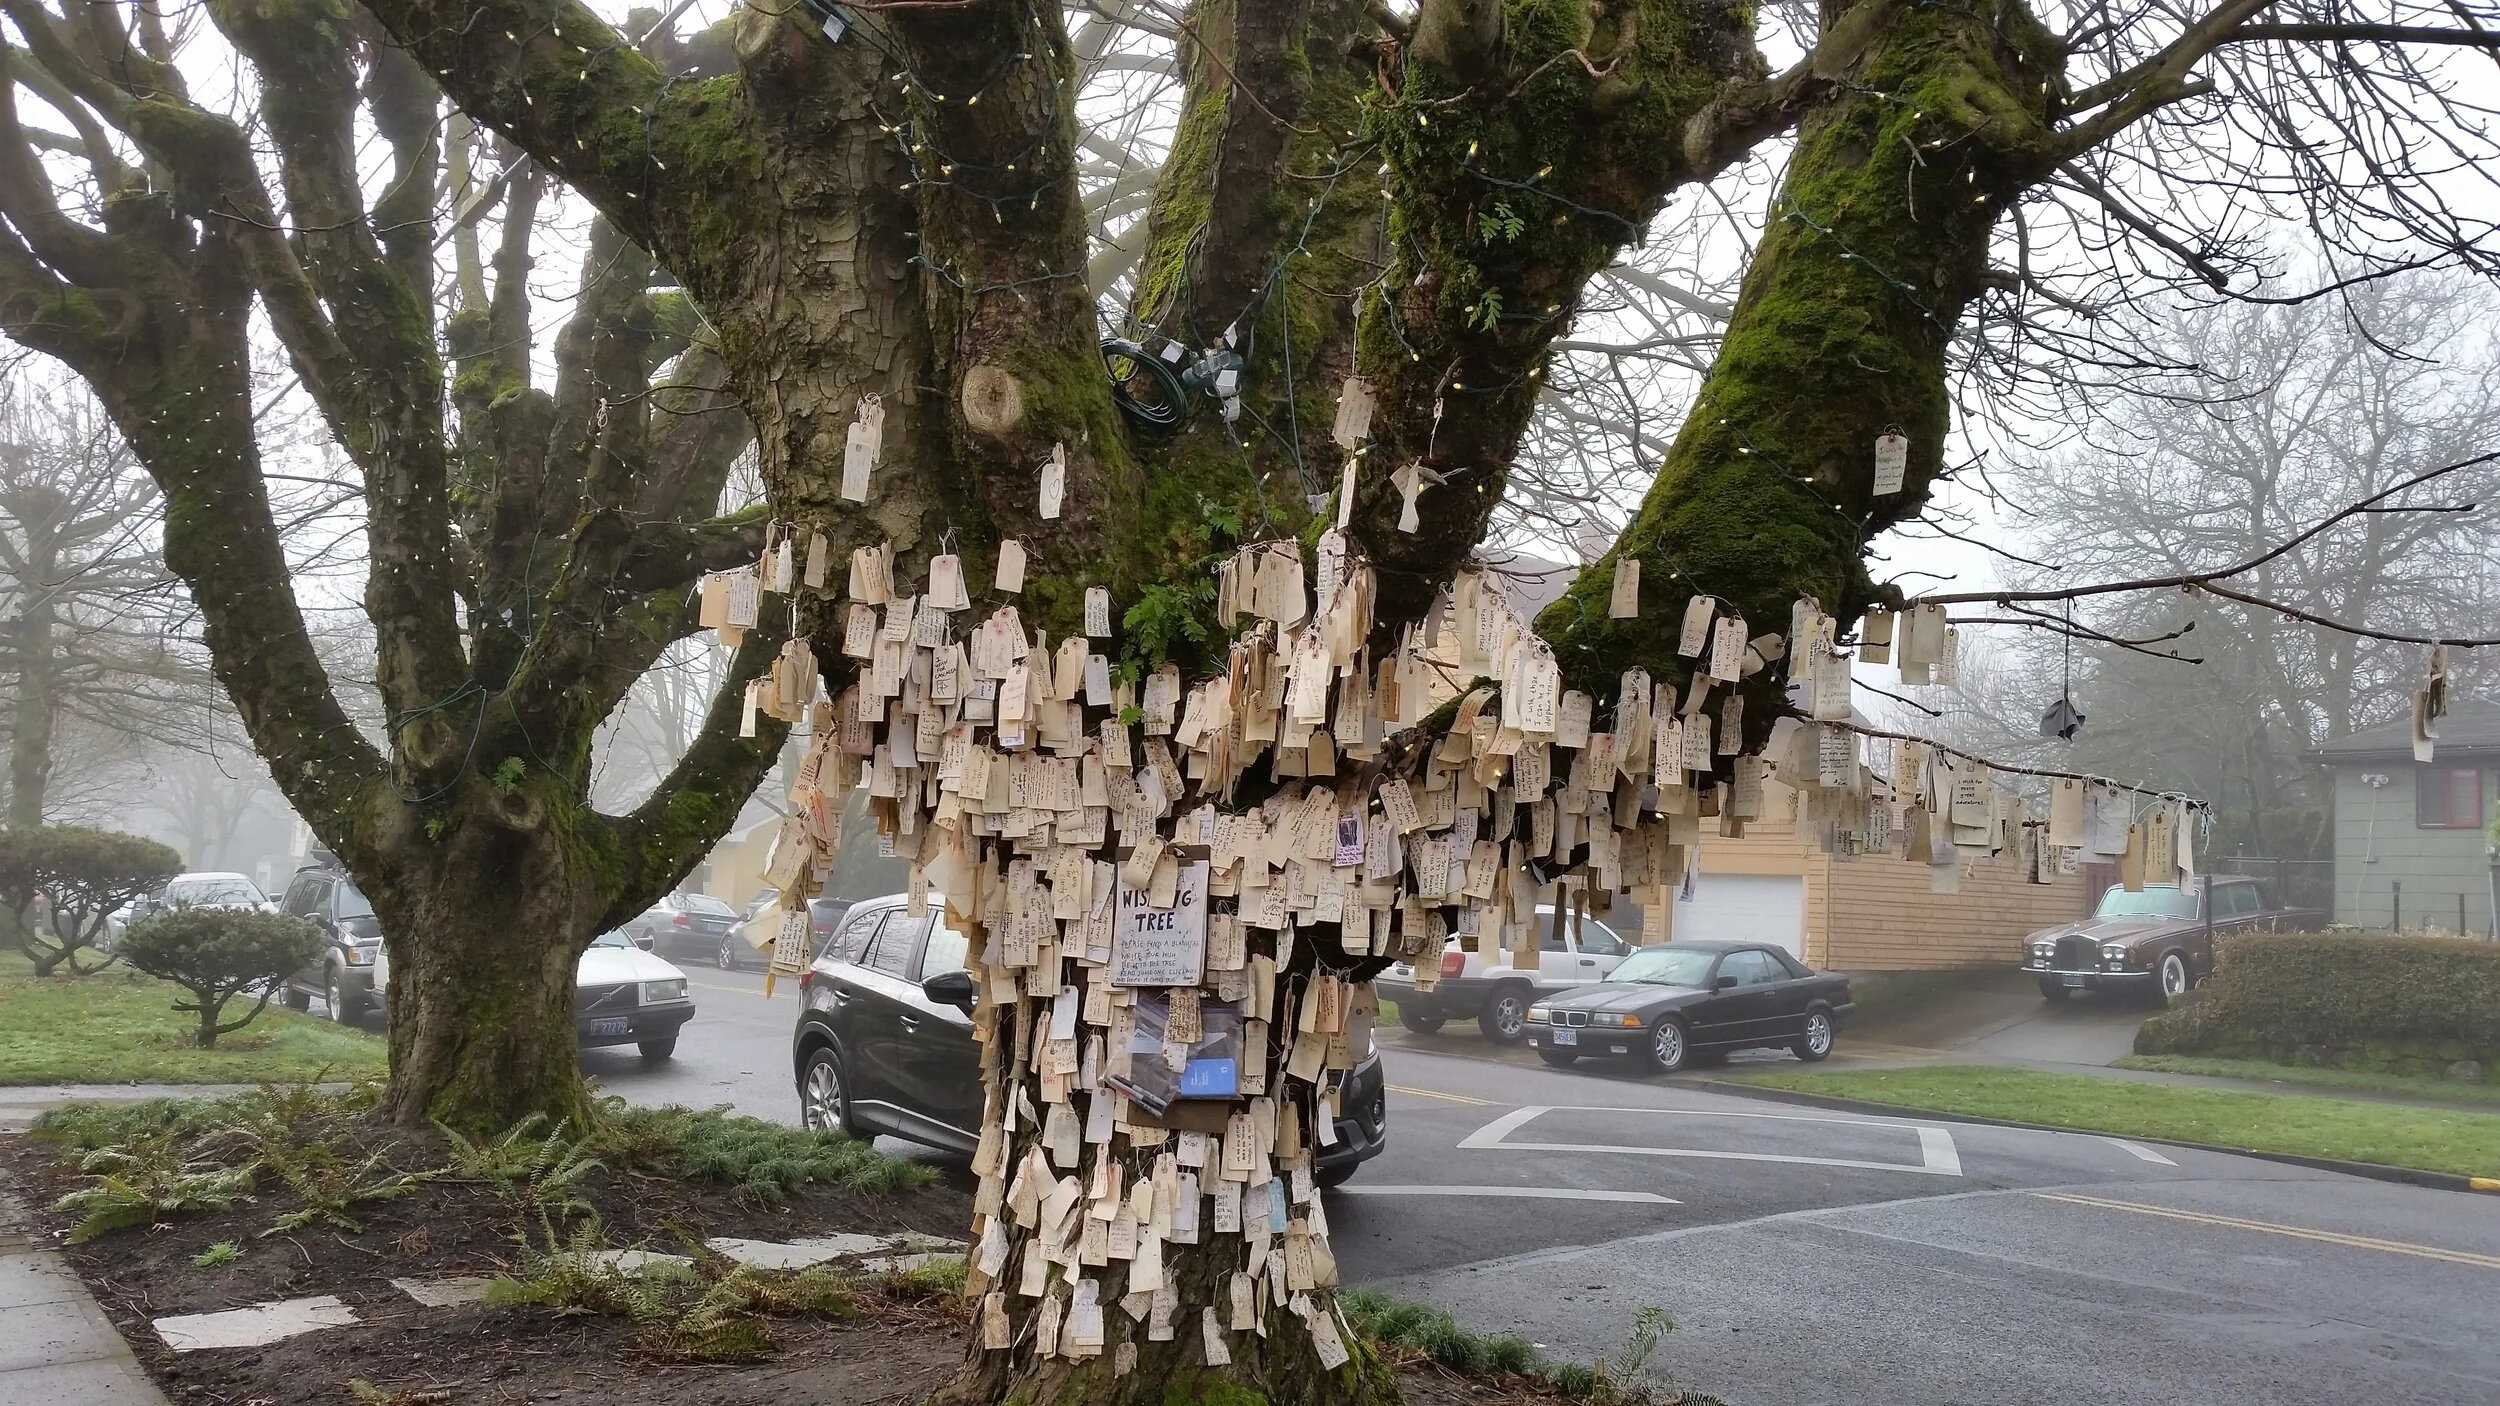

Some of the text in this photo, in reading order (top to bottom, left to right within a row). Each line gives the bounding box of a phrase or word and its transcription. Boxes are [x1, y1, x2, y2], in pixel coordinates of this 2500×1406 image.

[1476, 608, 1487, 651] better place
[1538, 692, 1544, 700] be
[1545, 670, 1556, 726] dolphin trainer
[1135, 912, 1175, 932] TREE
[1122, 940, 1143, 948] PLEASE
[602, 1022, 626, 1032] 27279
